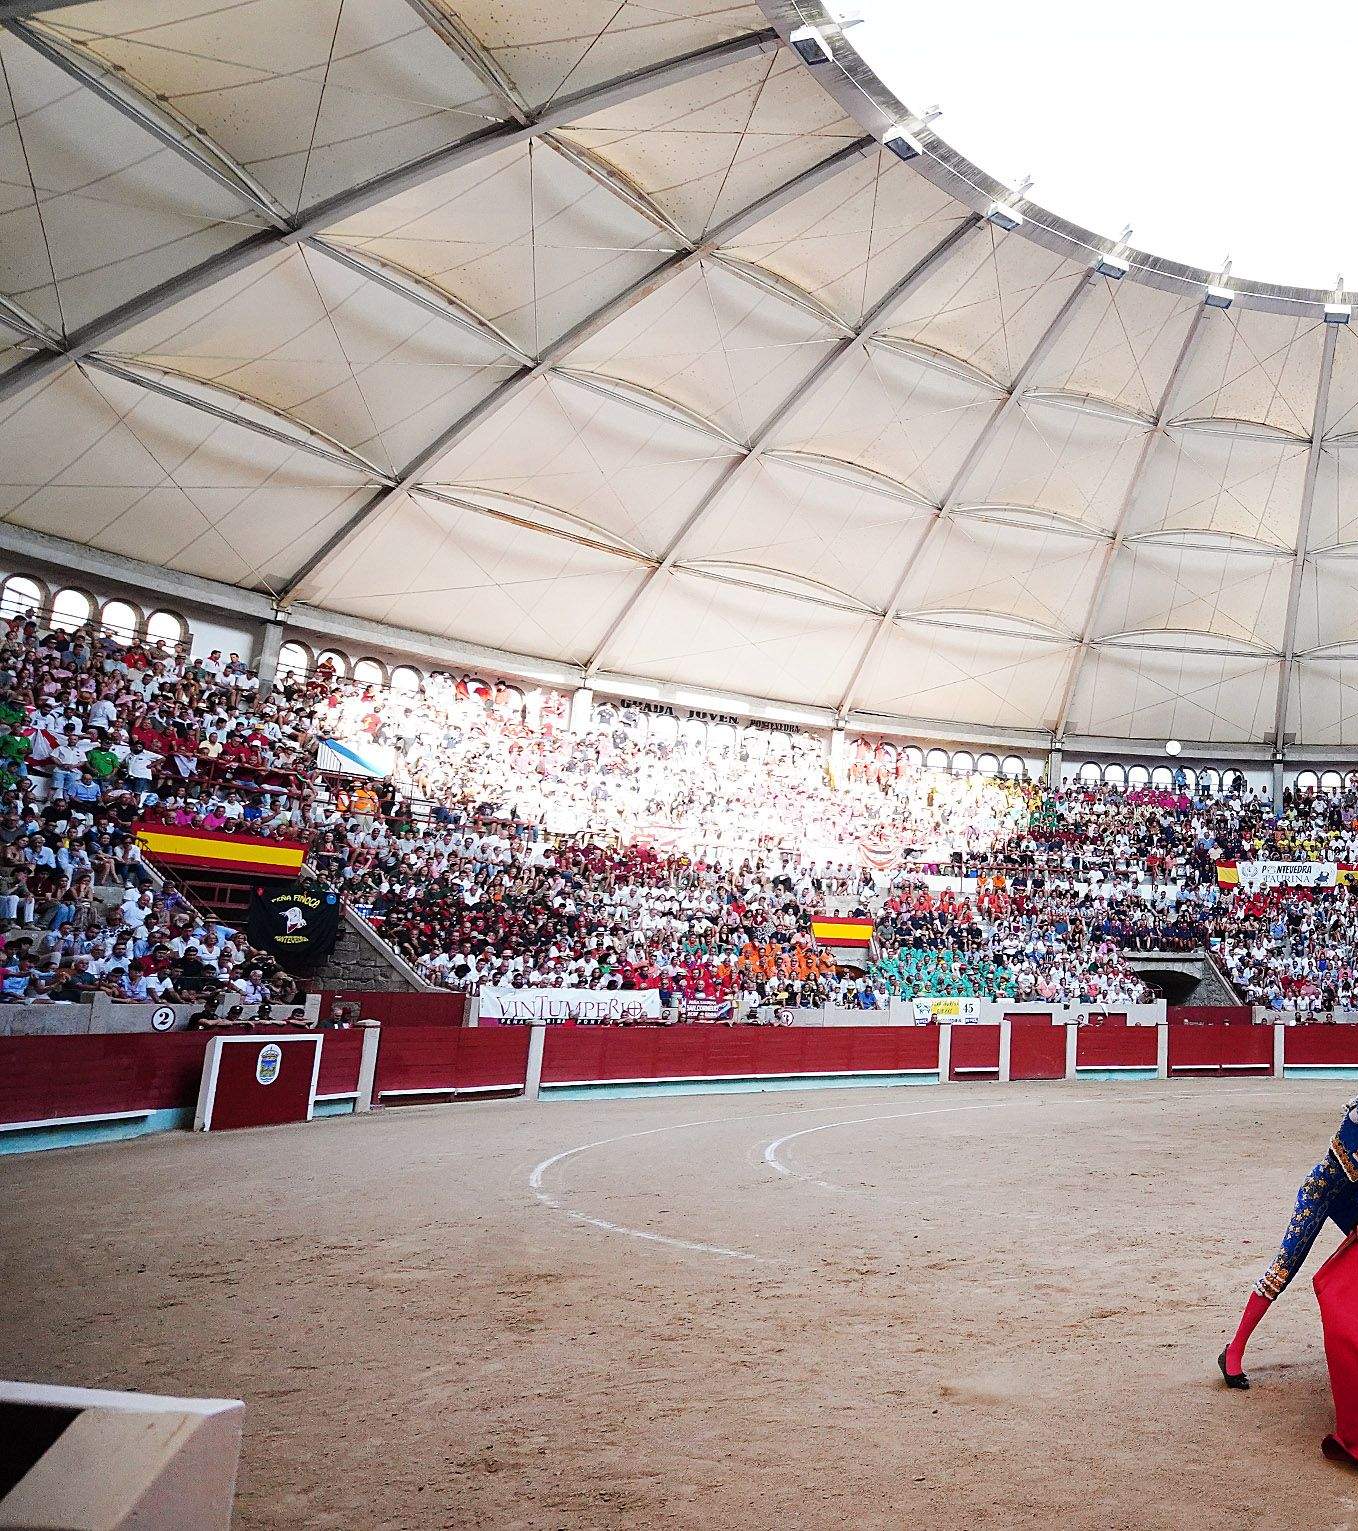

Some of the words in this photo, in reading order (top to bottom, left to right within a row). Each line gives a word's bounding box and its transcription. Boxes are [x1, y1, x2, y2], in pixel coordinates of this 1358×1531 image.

[1261, 865, 1312, 874] PONTEVEDRA
[1264, 874, 1311, 884] TAURINA
[963, 1003, 974, 1014] 45
[158, 1012, 170, 1026] 2
